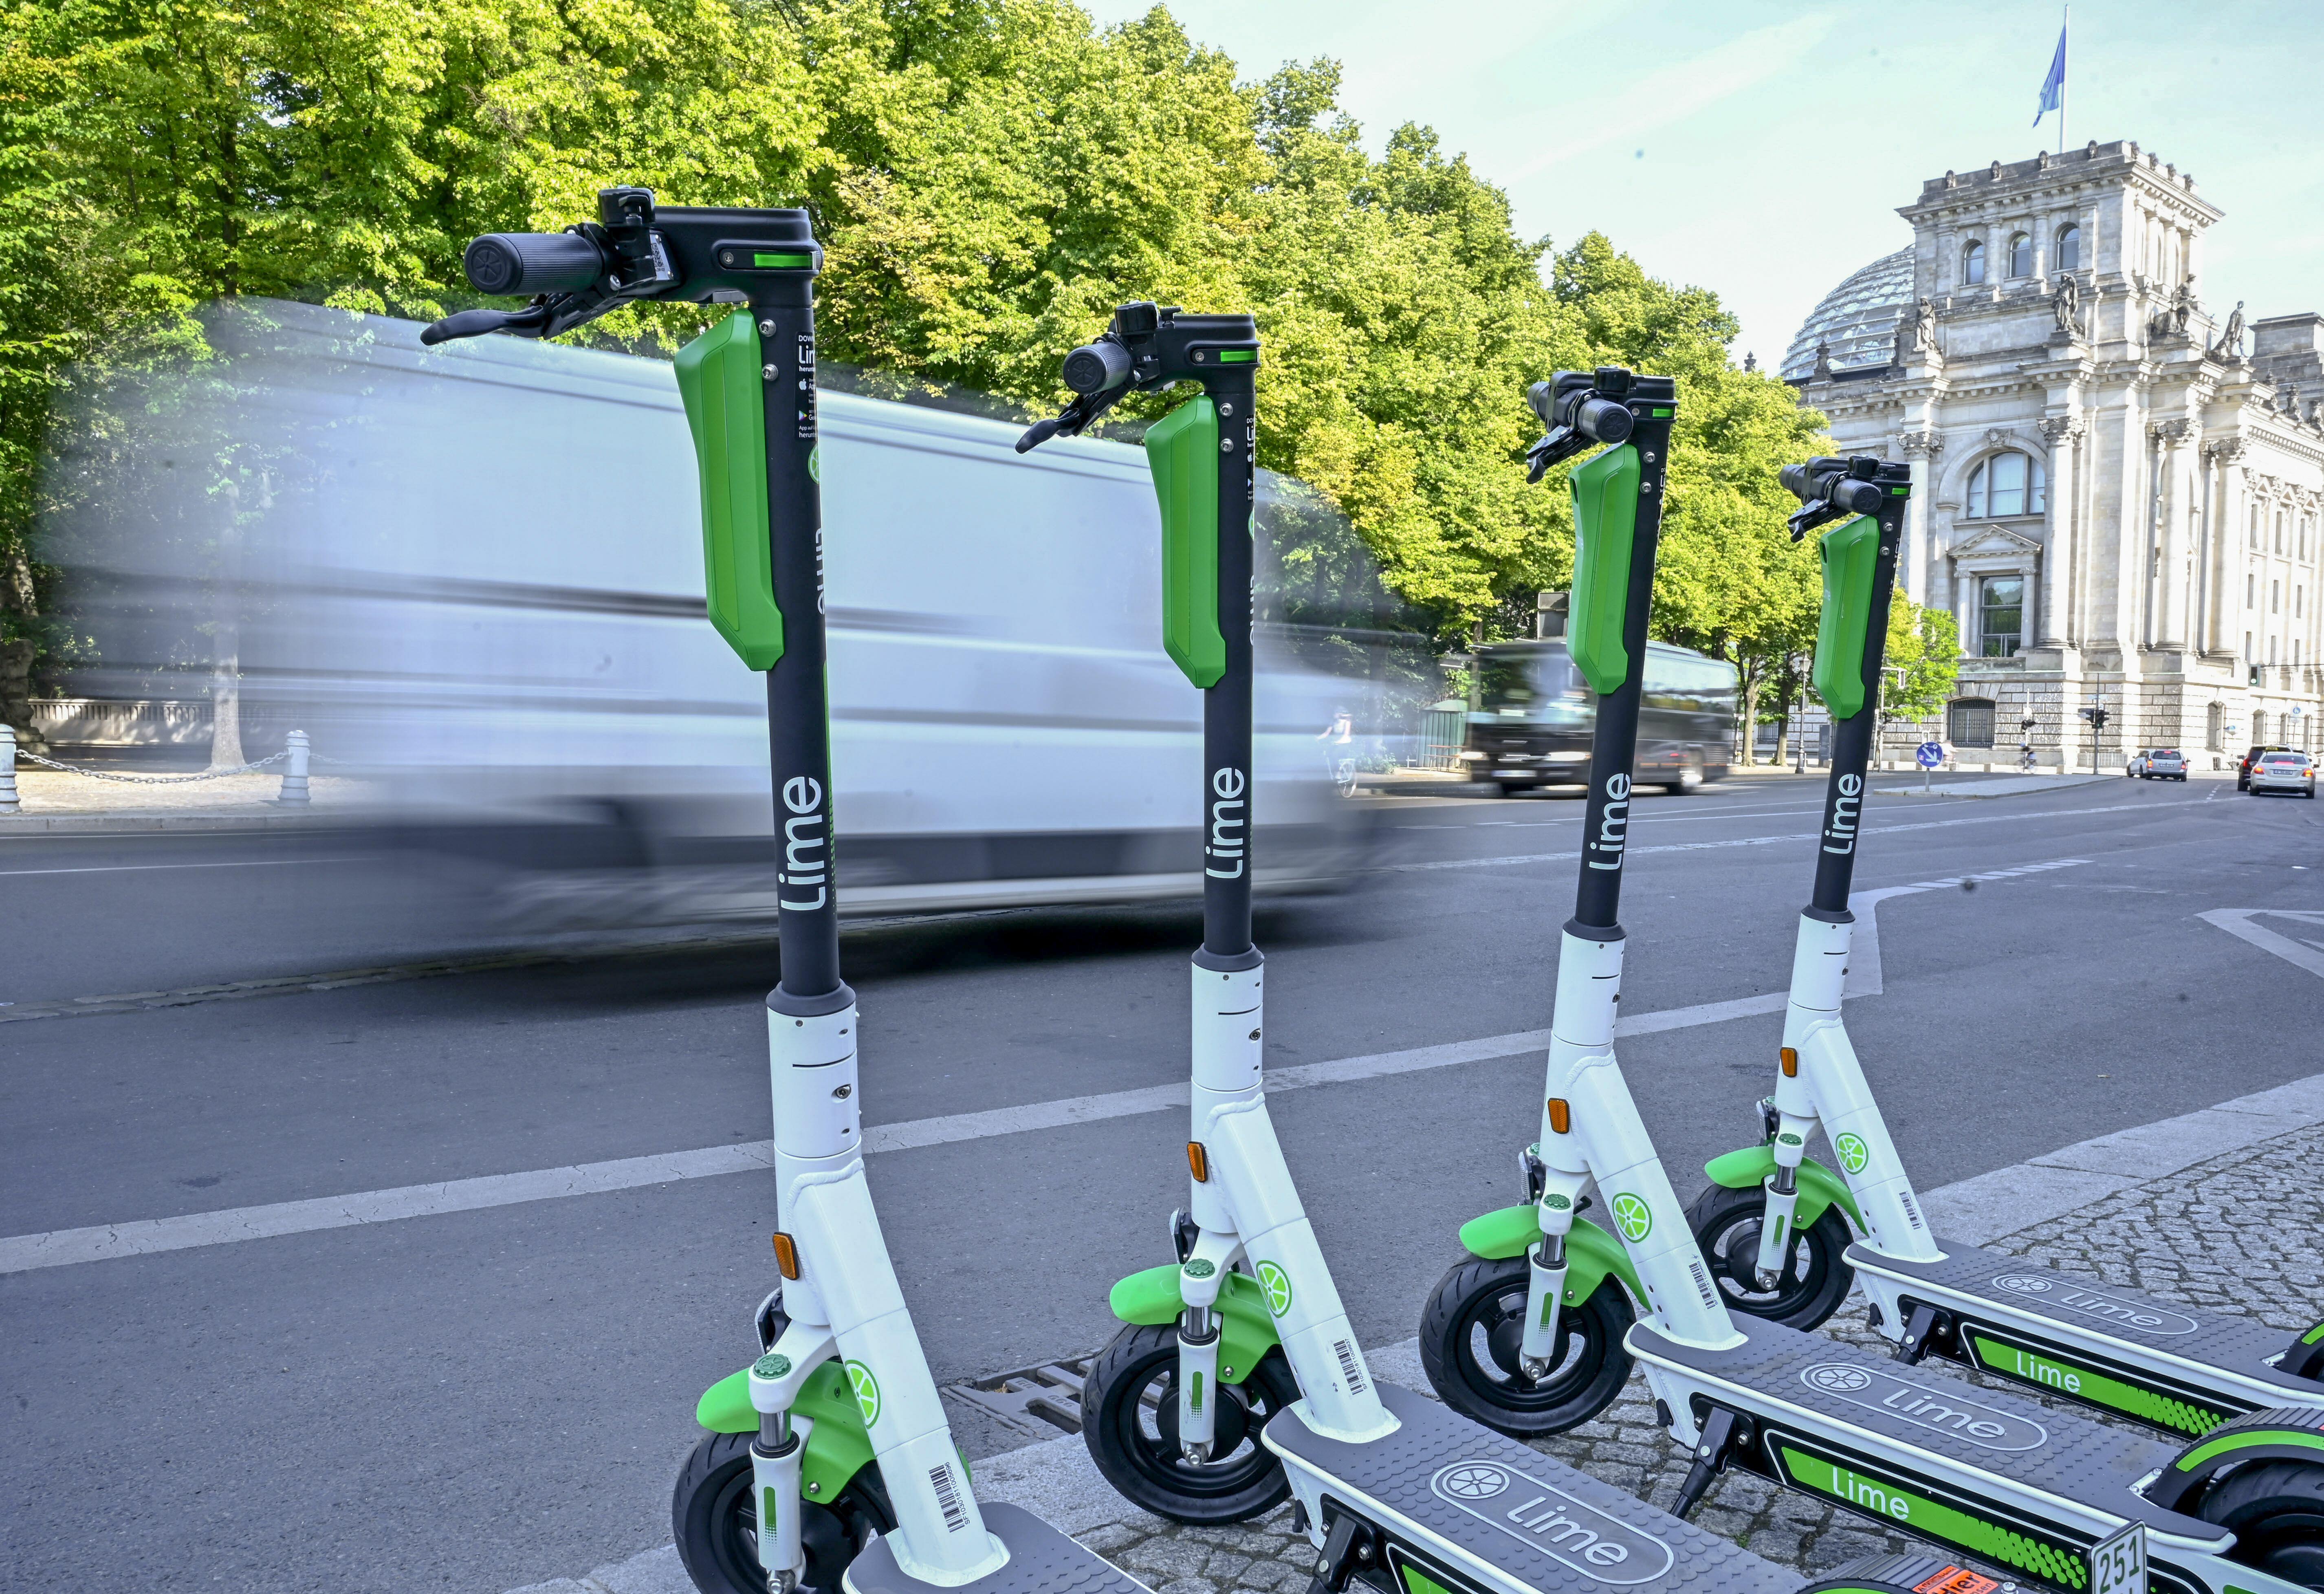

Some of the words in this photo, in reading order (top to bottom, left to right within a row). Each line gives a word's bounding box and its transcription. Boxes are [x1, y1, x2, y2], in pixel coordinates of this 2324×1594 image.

[779, 776, 825, 911] Lime
[1206, 767, 1244, 879] Lime
[1589, 773, 1630, 870] Lime
[1823, 773, 1861, 854] Lime
[2060, 1293, 2163, 1326] Lime
[1345, 1339, 1367, 1390] SF10301811009937
[2018, 1351, 2080, 1393] Lime
[1883, 1389, 2005, 1438] Lime
[944, 1462, 970, 1525] SF10301811005696
[1833, 1467, 1909, 1520] Lime
[1507, 1496, 1628, 1565] Lime
[2100, 1535, 2139, 1594] 251
